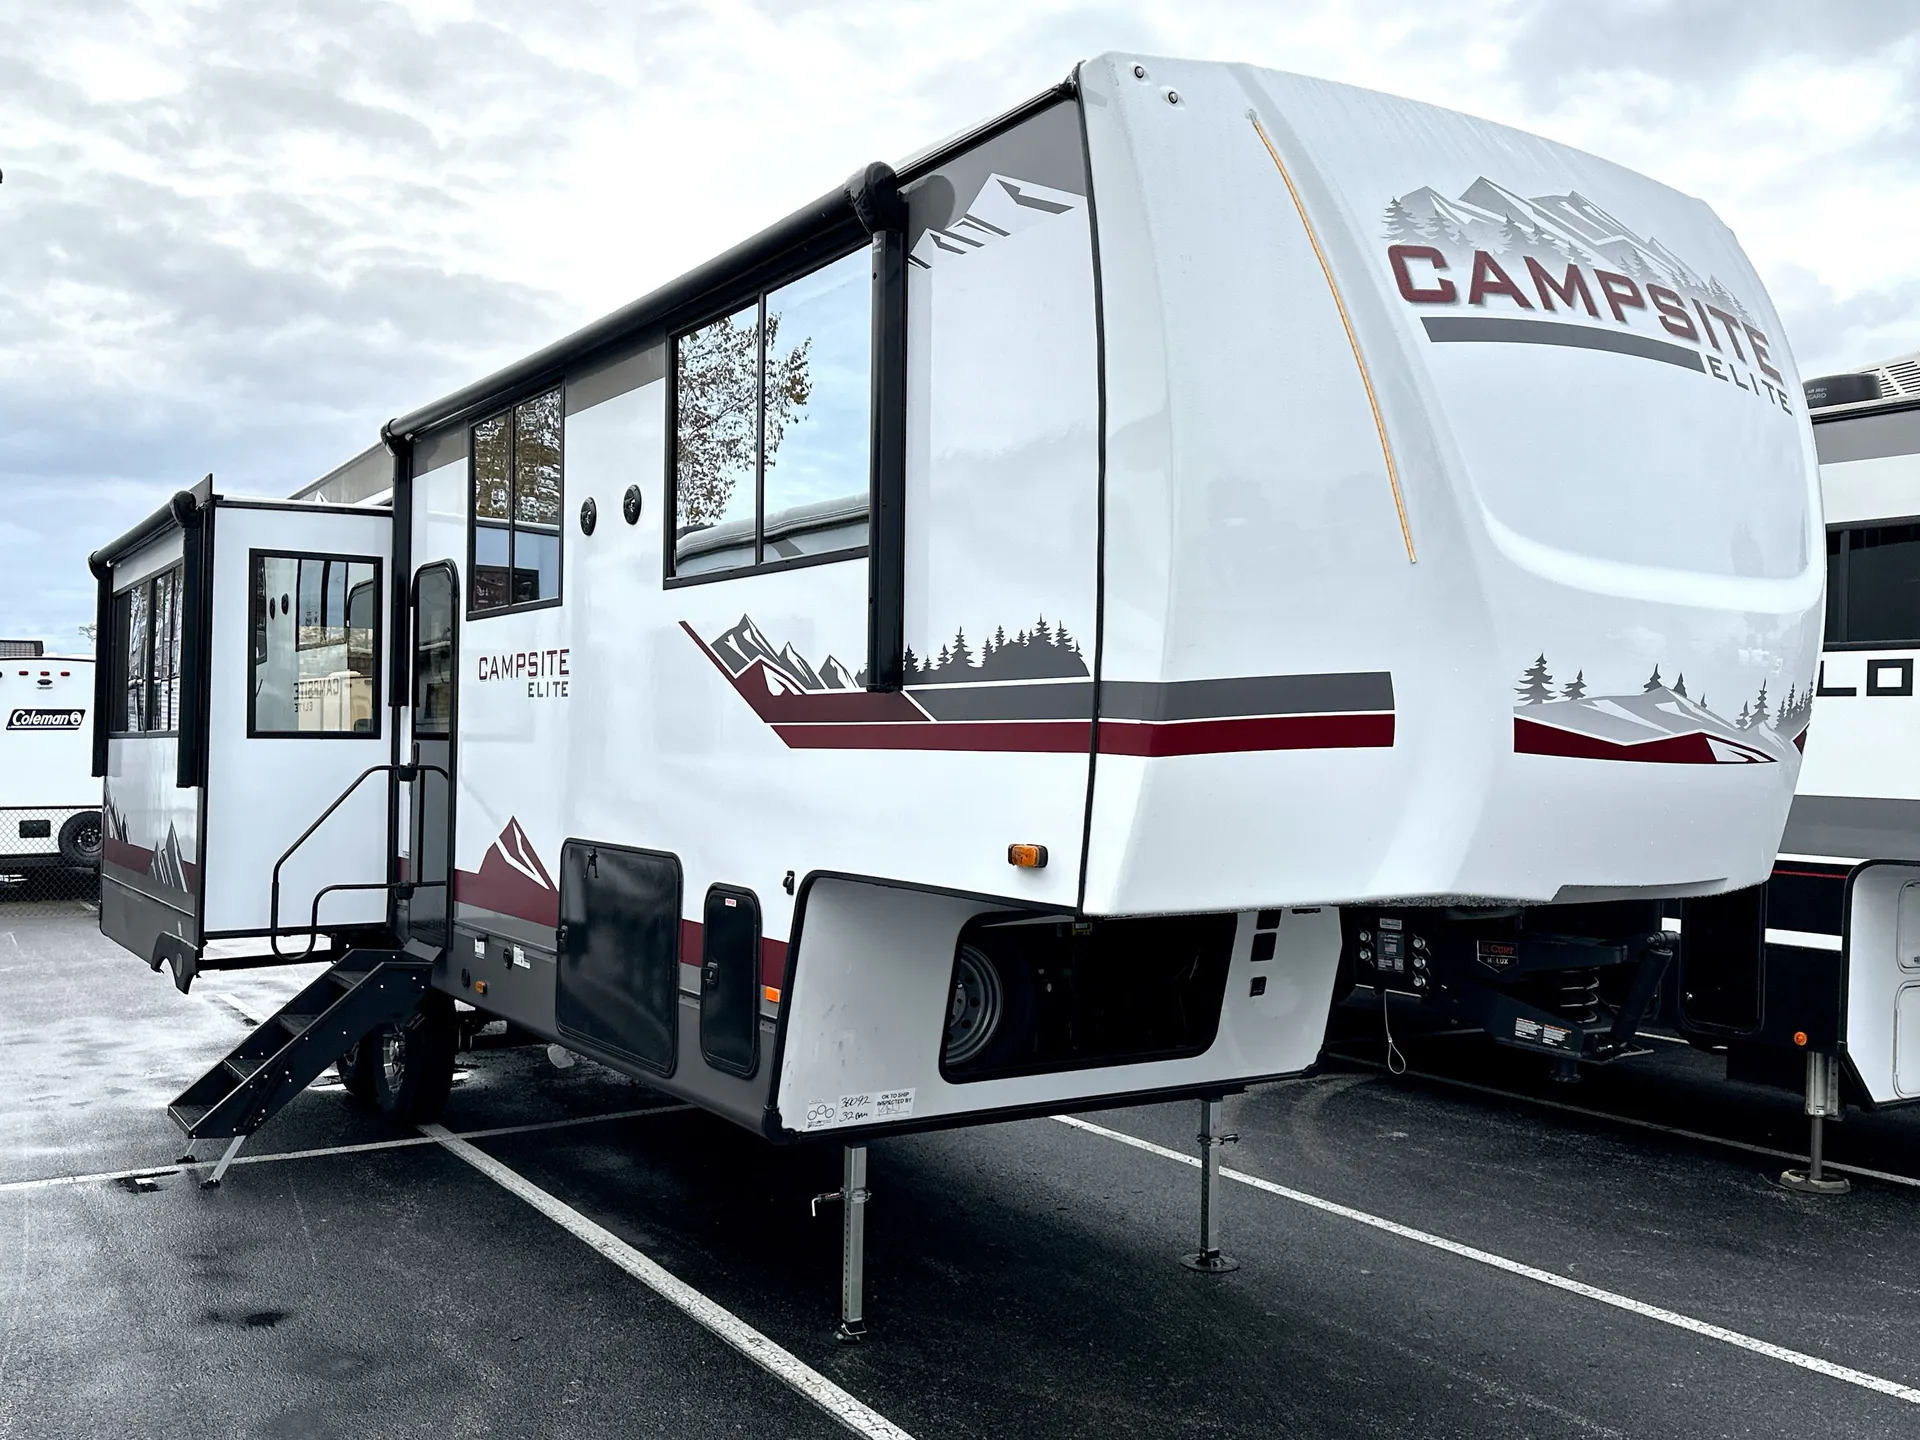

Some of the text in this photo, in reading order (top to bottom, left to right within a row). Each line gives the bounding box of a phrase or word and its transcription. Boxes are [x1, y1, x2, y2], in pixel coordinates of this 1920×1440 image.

[1387, 244, 1783, 386] CAMPSITE
[1706, 354, 1793, 416] ELITE
[479, 648, 570, 681] CAMPSITE
[527, 680, 569, 698] ELITE
[12, 710, 70, 726] Coleman
